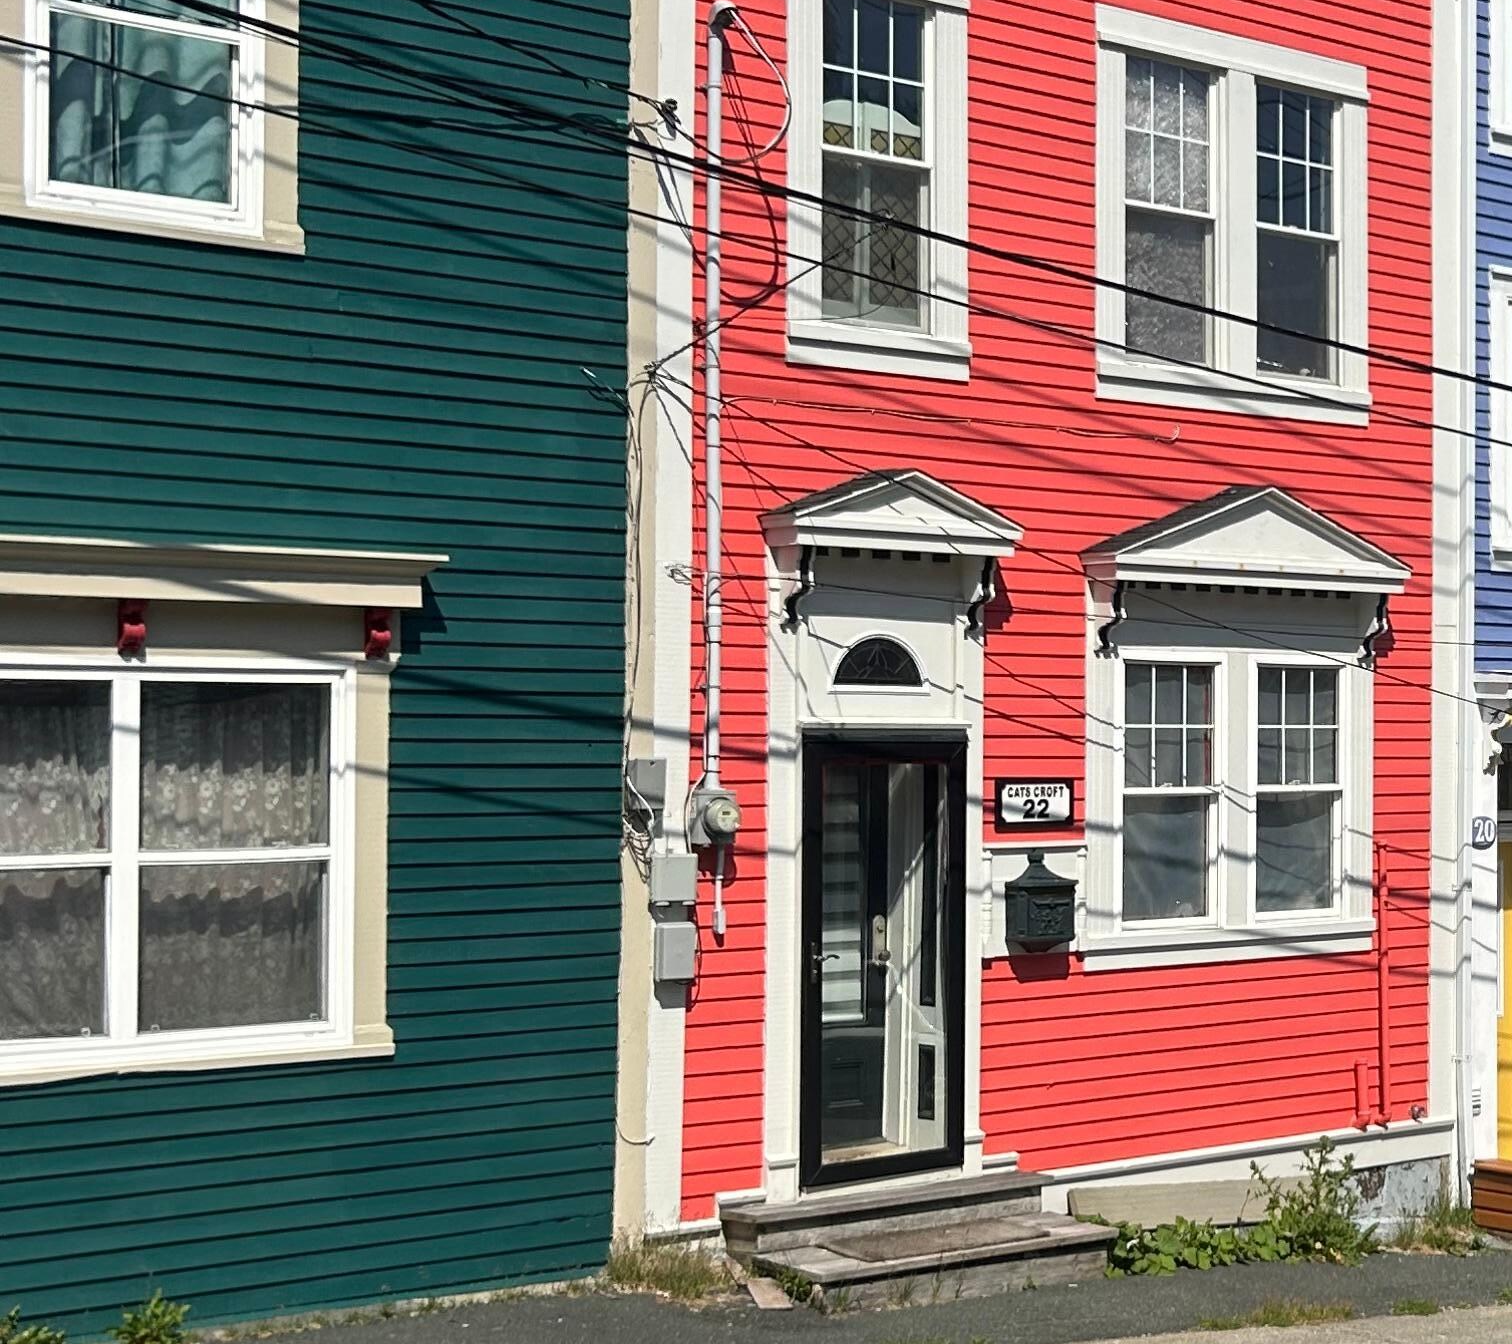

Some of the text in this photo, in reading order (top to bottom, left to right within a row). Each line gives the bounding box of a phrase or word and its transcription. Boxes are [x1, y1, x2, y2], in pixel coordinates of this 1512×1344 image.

[1007, 785, 1064, 798] CATS CROFT
[1022, 798, 1050, 820] 22
[1474, 818, 1496, 843] 20
